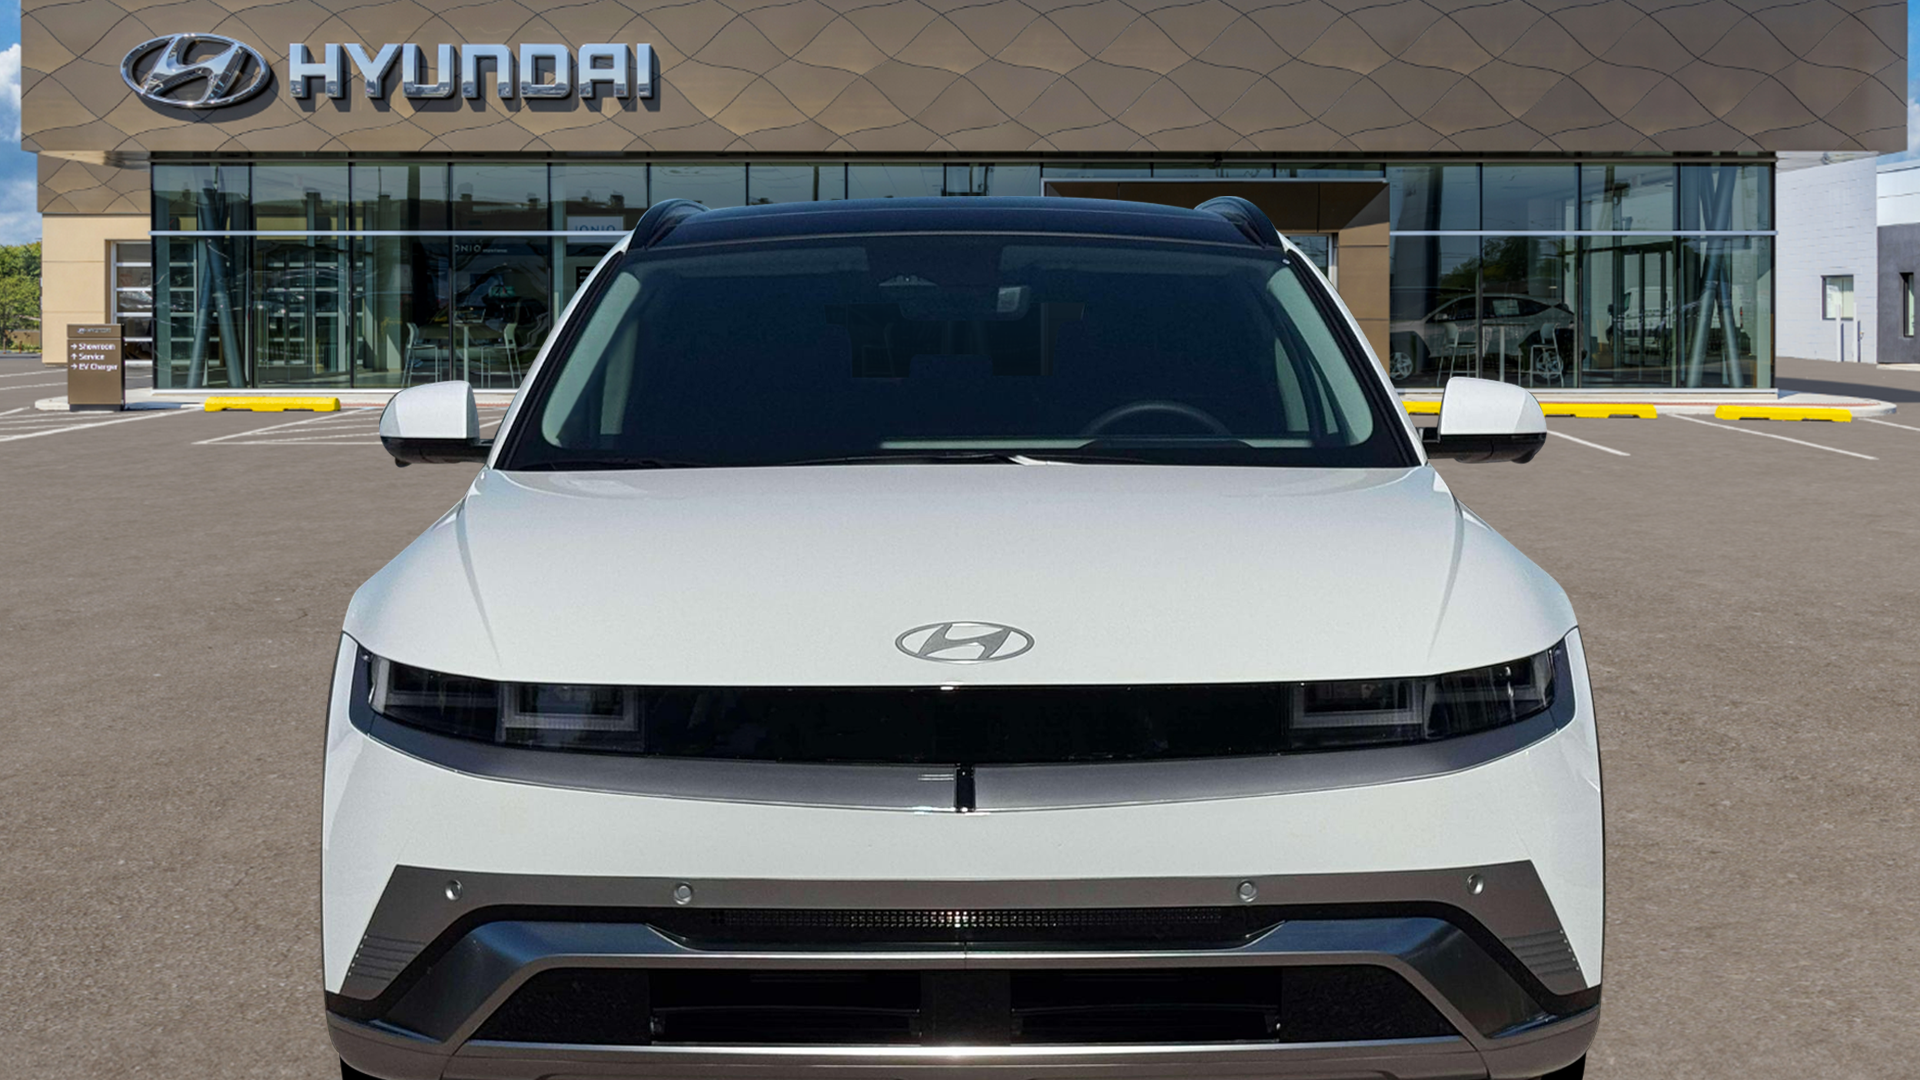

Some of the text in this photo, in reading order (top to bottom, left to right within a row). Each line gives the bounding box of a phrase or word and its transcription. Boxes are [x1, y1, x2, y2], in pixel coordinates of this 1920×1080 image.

[289, 42, 656, 99] HYUNDAI
[78, 352, 105, 361] Service
[90, 363, 118, 372] Charger
